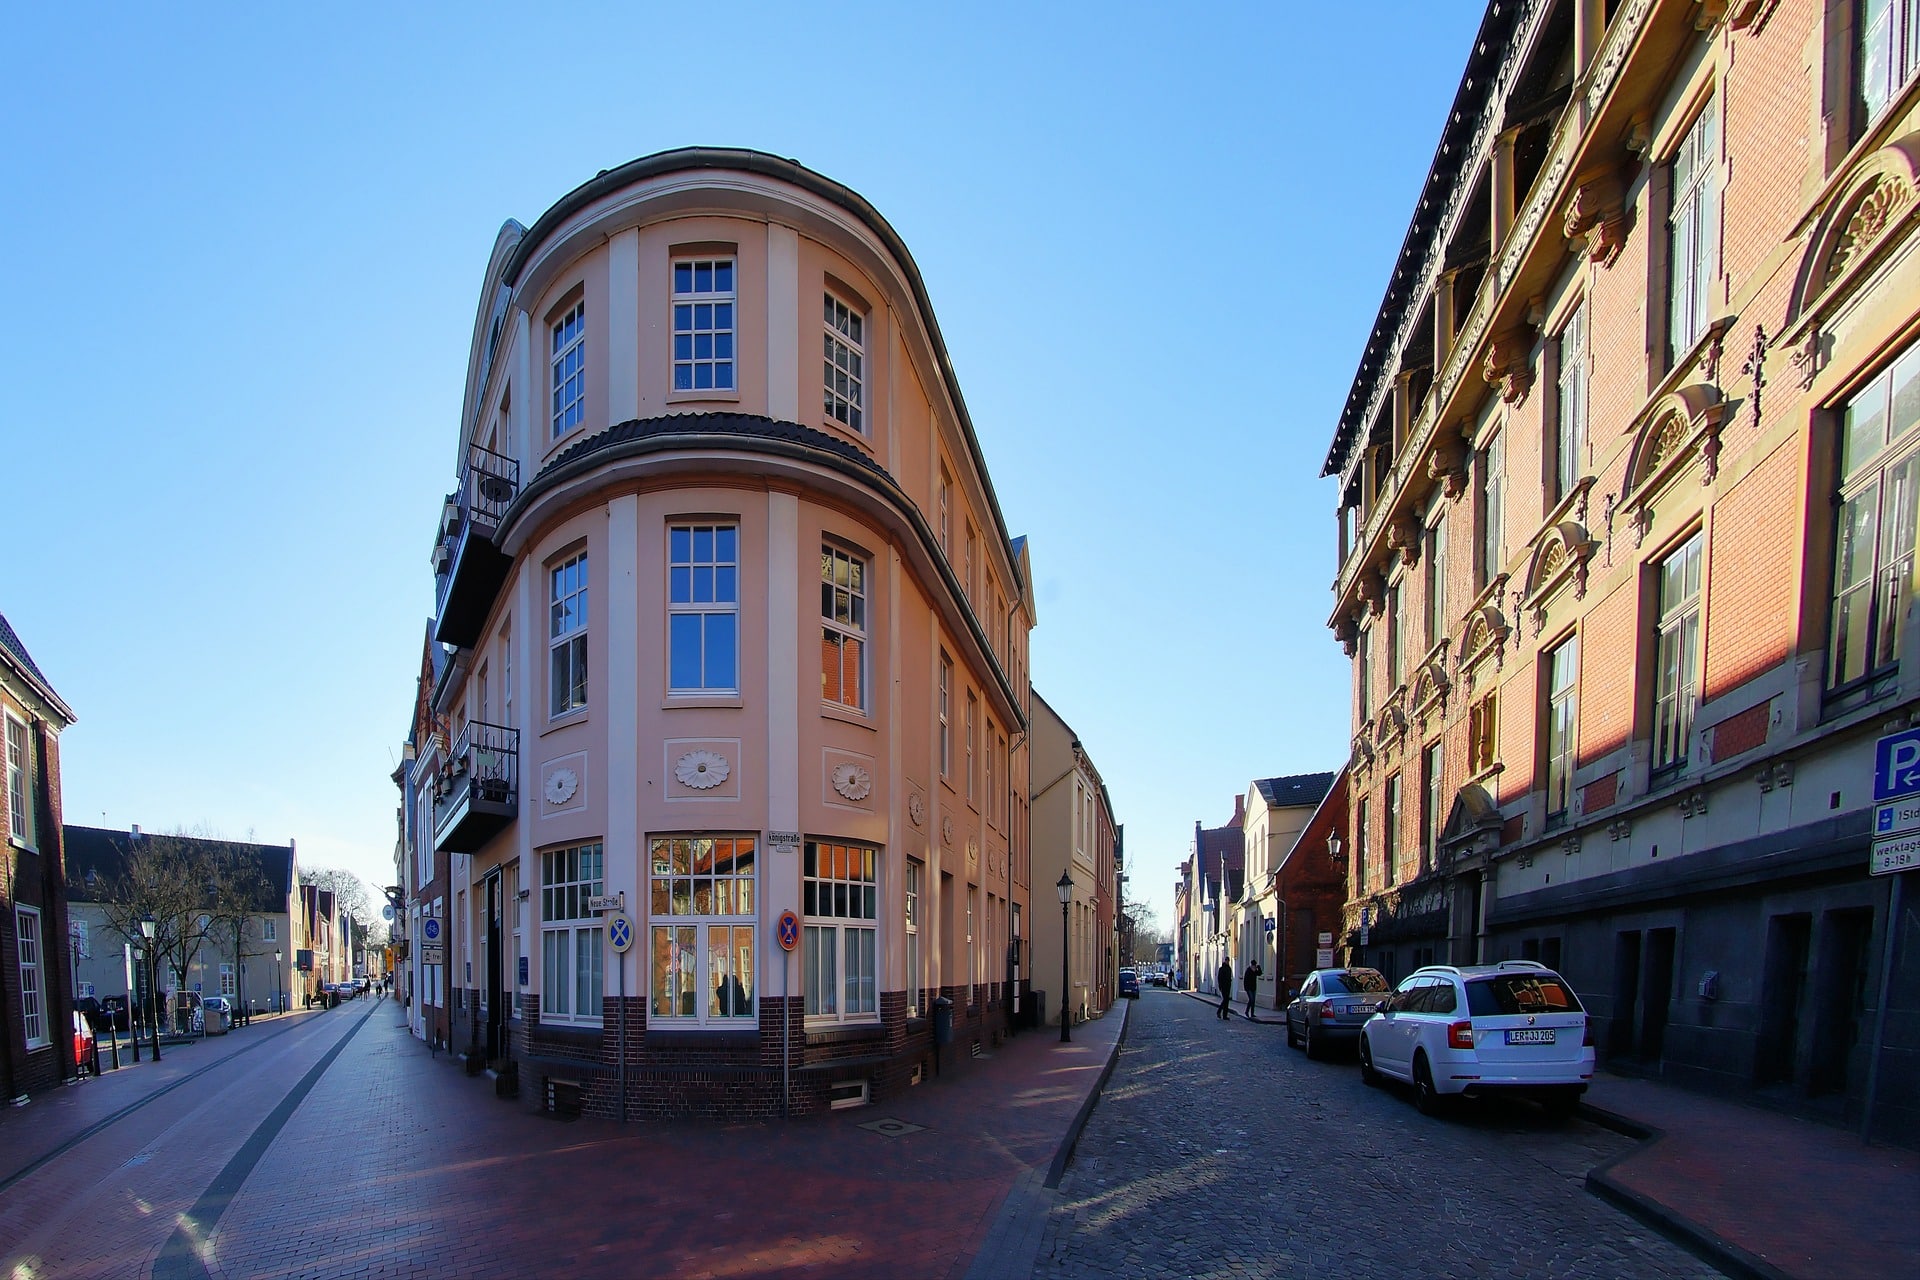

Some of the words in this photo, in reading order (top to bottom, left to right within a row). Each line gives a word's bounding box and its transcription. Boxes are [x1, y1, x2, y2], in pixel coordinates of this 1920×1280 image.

[1888, 738, 1920, 790] P
[769, 832, 801, 844] Königstraße
[1876, 840, 1920, 857] werktags
[590, 899, 602, 908] Neue
[603, 897, 618, 907] Straße
[1510, 1031, 1524, 1042] LER
[1541, 1031, 1554, 1041] 205
